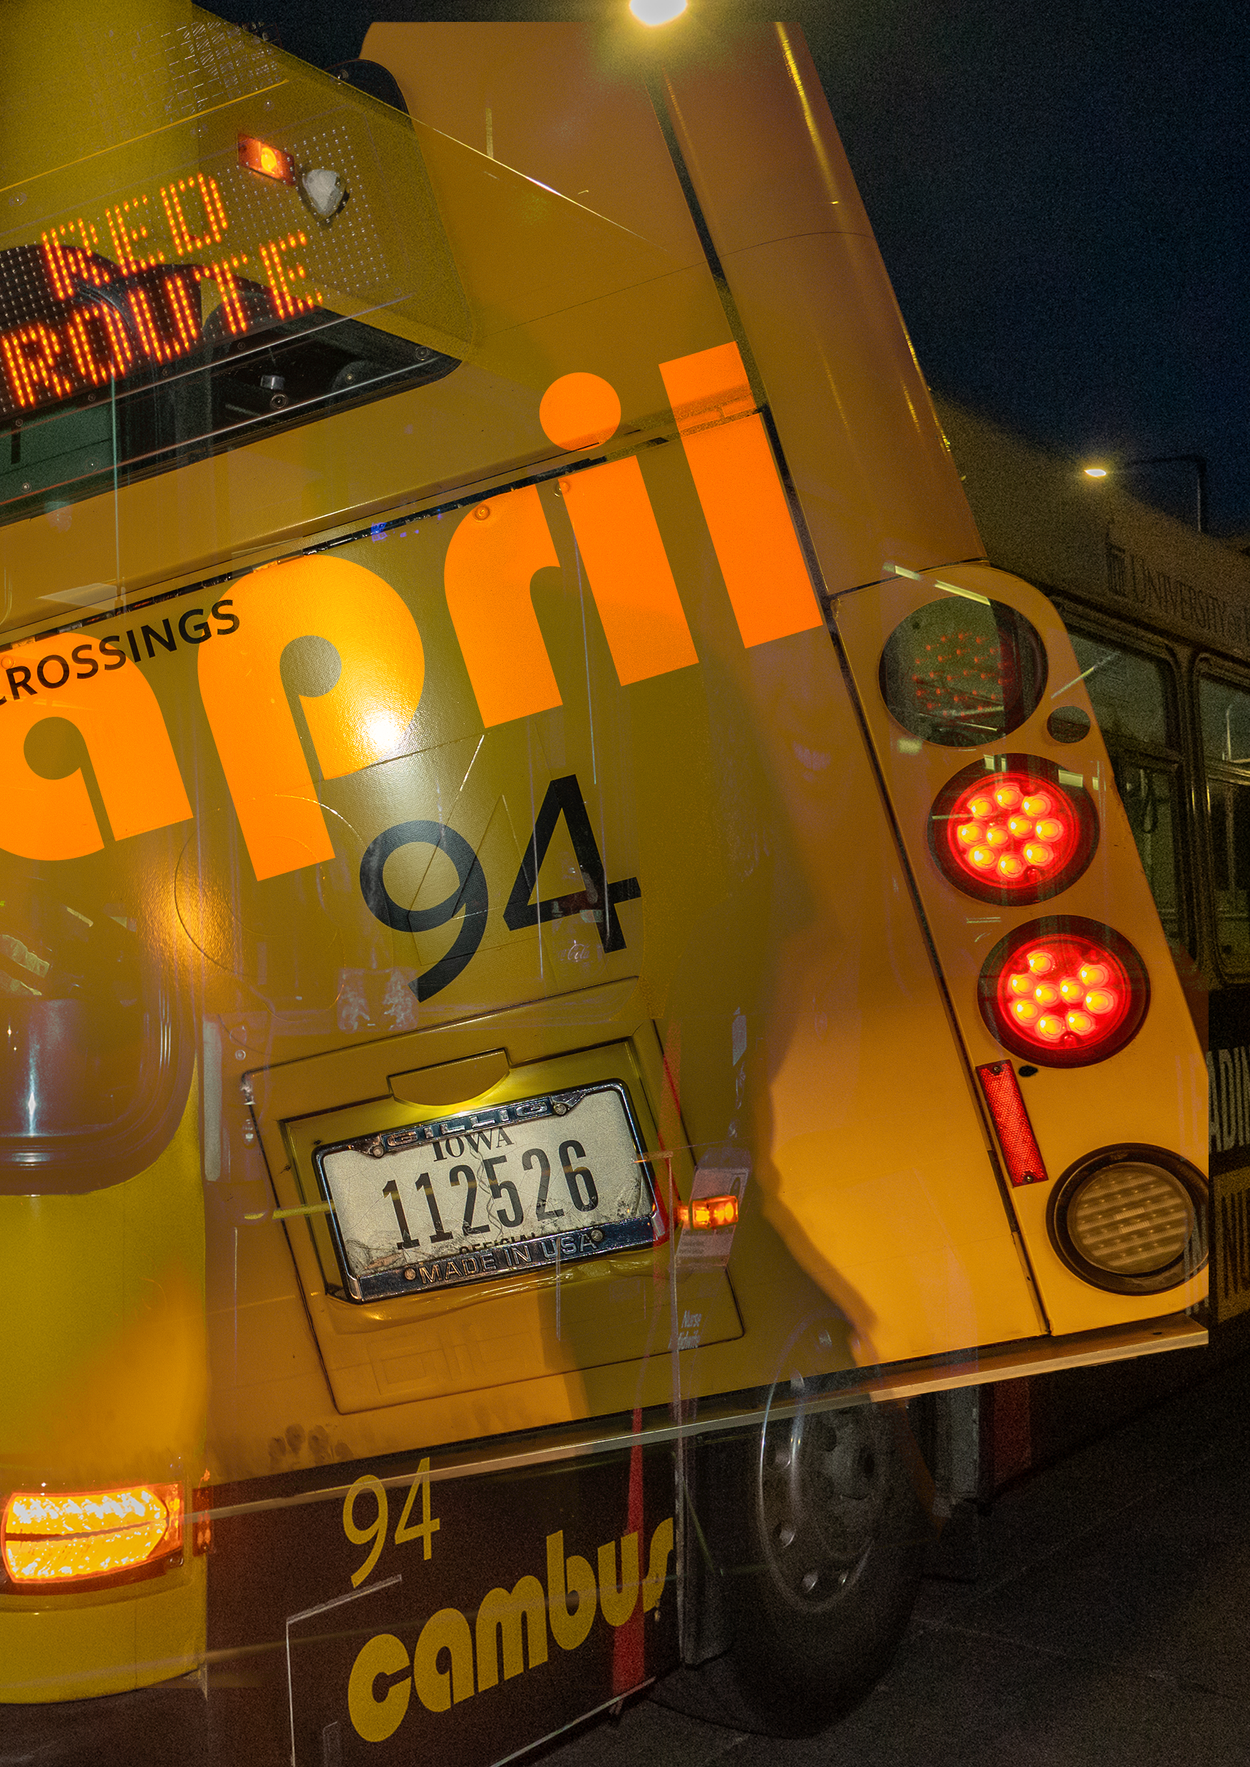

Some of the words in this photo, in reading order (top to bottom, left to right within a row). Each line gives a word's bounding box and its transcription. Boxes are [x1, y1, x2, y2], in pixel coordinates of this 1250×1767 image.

[40, 172, 228, 301] RED
[0, 229, 325, 408] ROUTE
[359, 774, 641, 1004] 94
[386, 1101, 549, 1149] GILLIG
[432, 1125, 515, 1163] IOWA
[382, 1139, 600, 1252] 112526
[419, 1250, 498, 1286] MADE
[504, 1244, 533, 1267] IN
[540, 1232, 598, 1260] USA
[342, 1456, 441, 1589] 94
[347, 1516, 675, 1743] cambus
